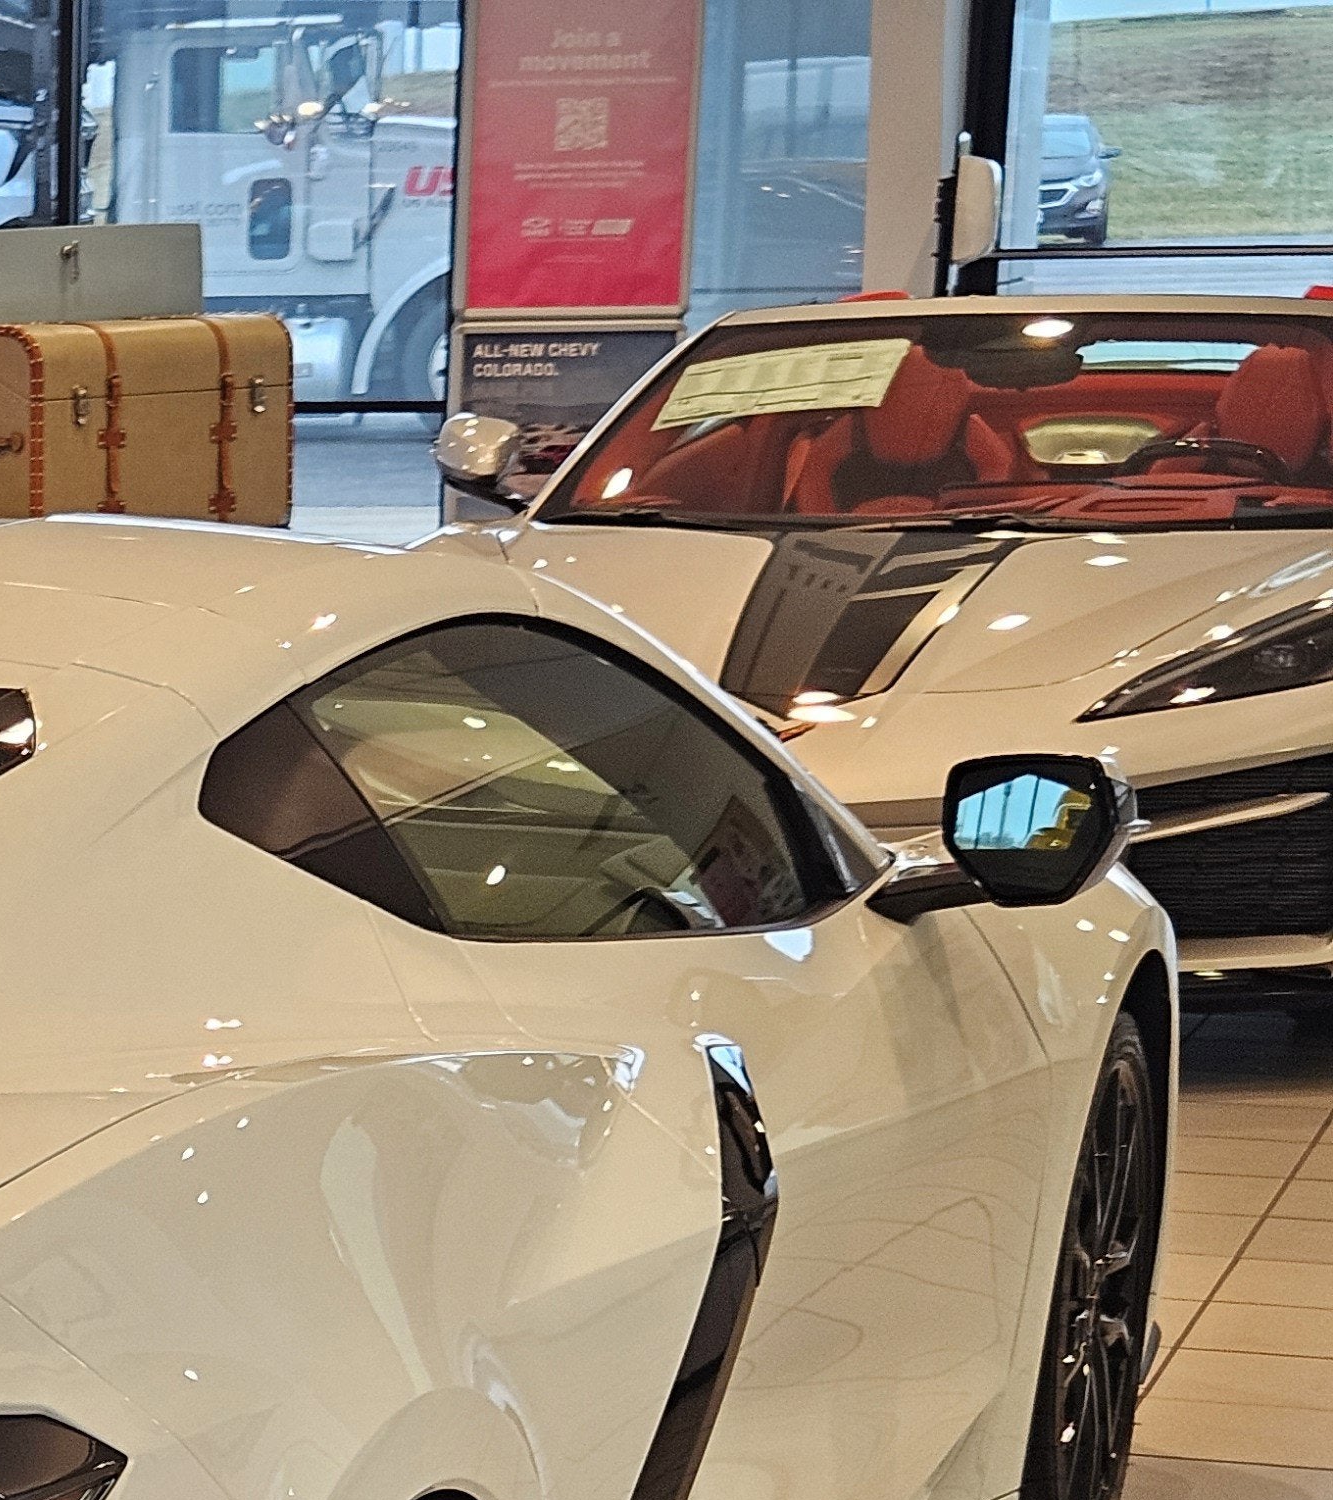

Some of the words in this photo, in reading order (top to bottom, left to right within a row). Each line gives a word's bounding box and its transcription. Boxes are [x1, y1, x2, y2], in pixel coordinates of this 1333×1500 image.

[472, 343, 545, 358] ALL-NEW
[547, 342, 601, 357] CHEVY
[472, 362, 560, 377] COLORADO.
